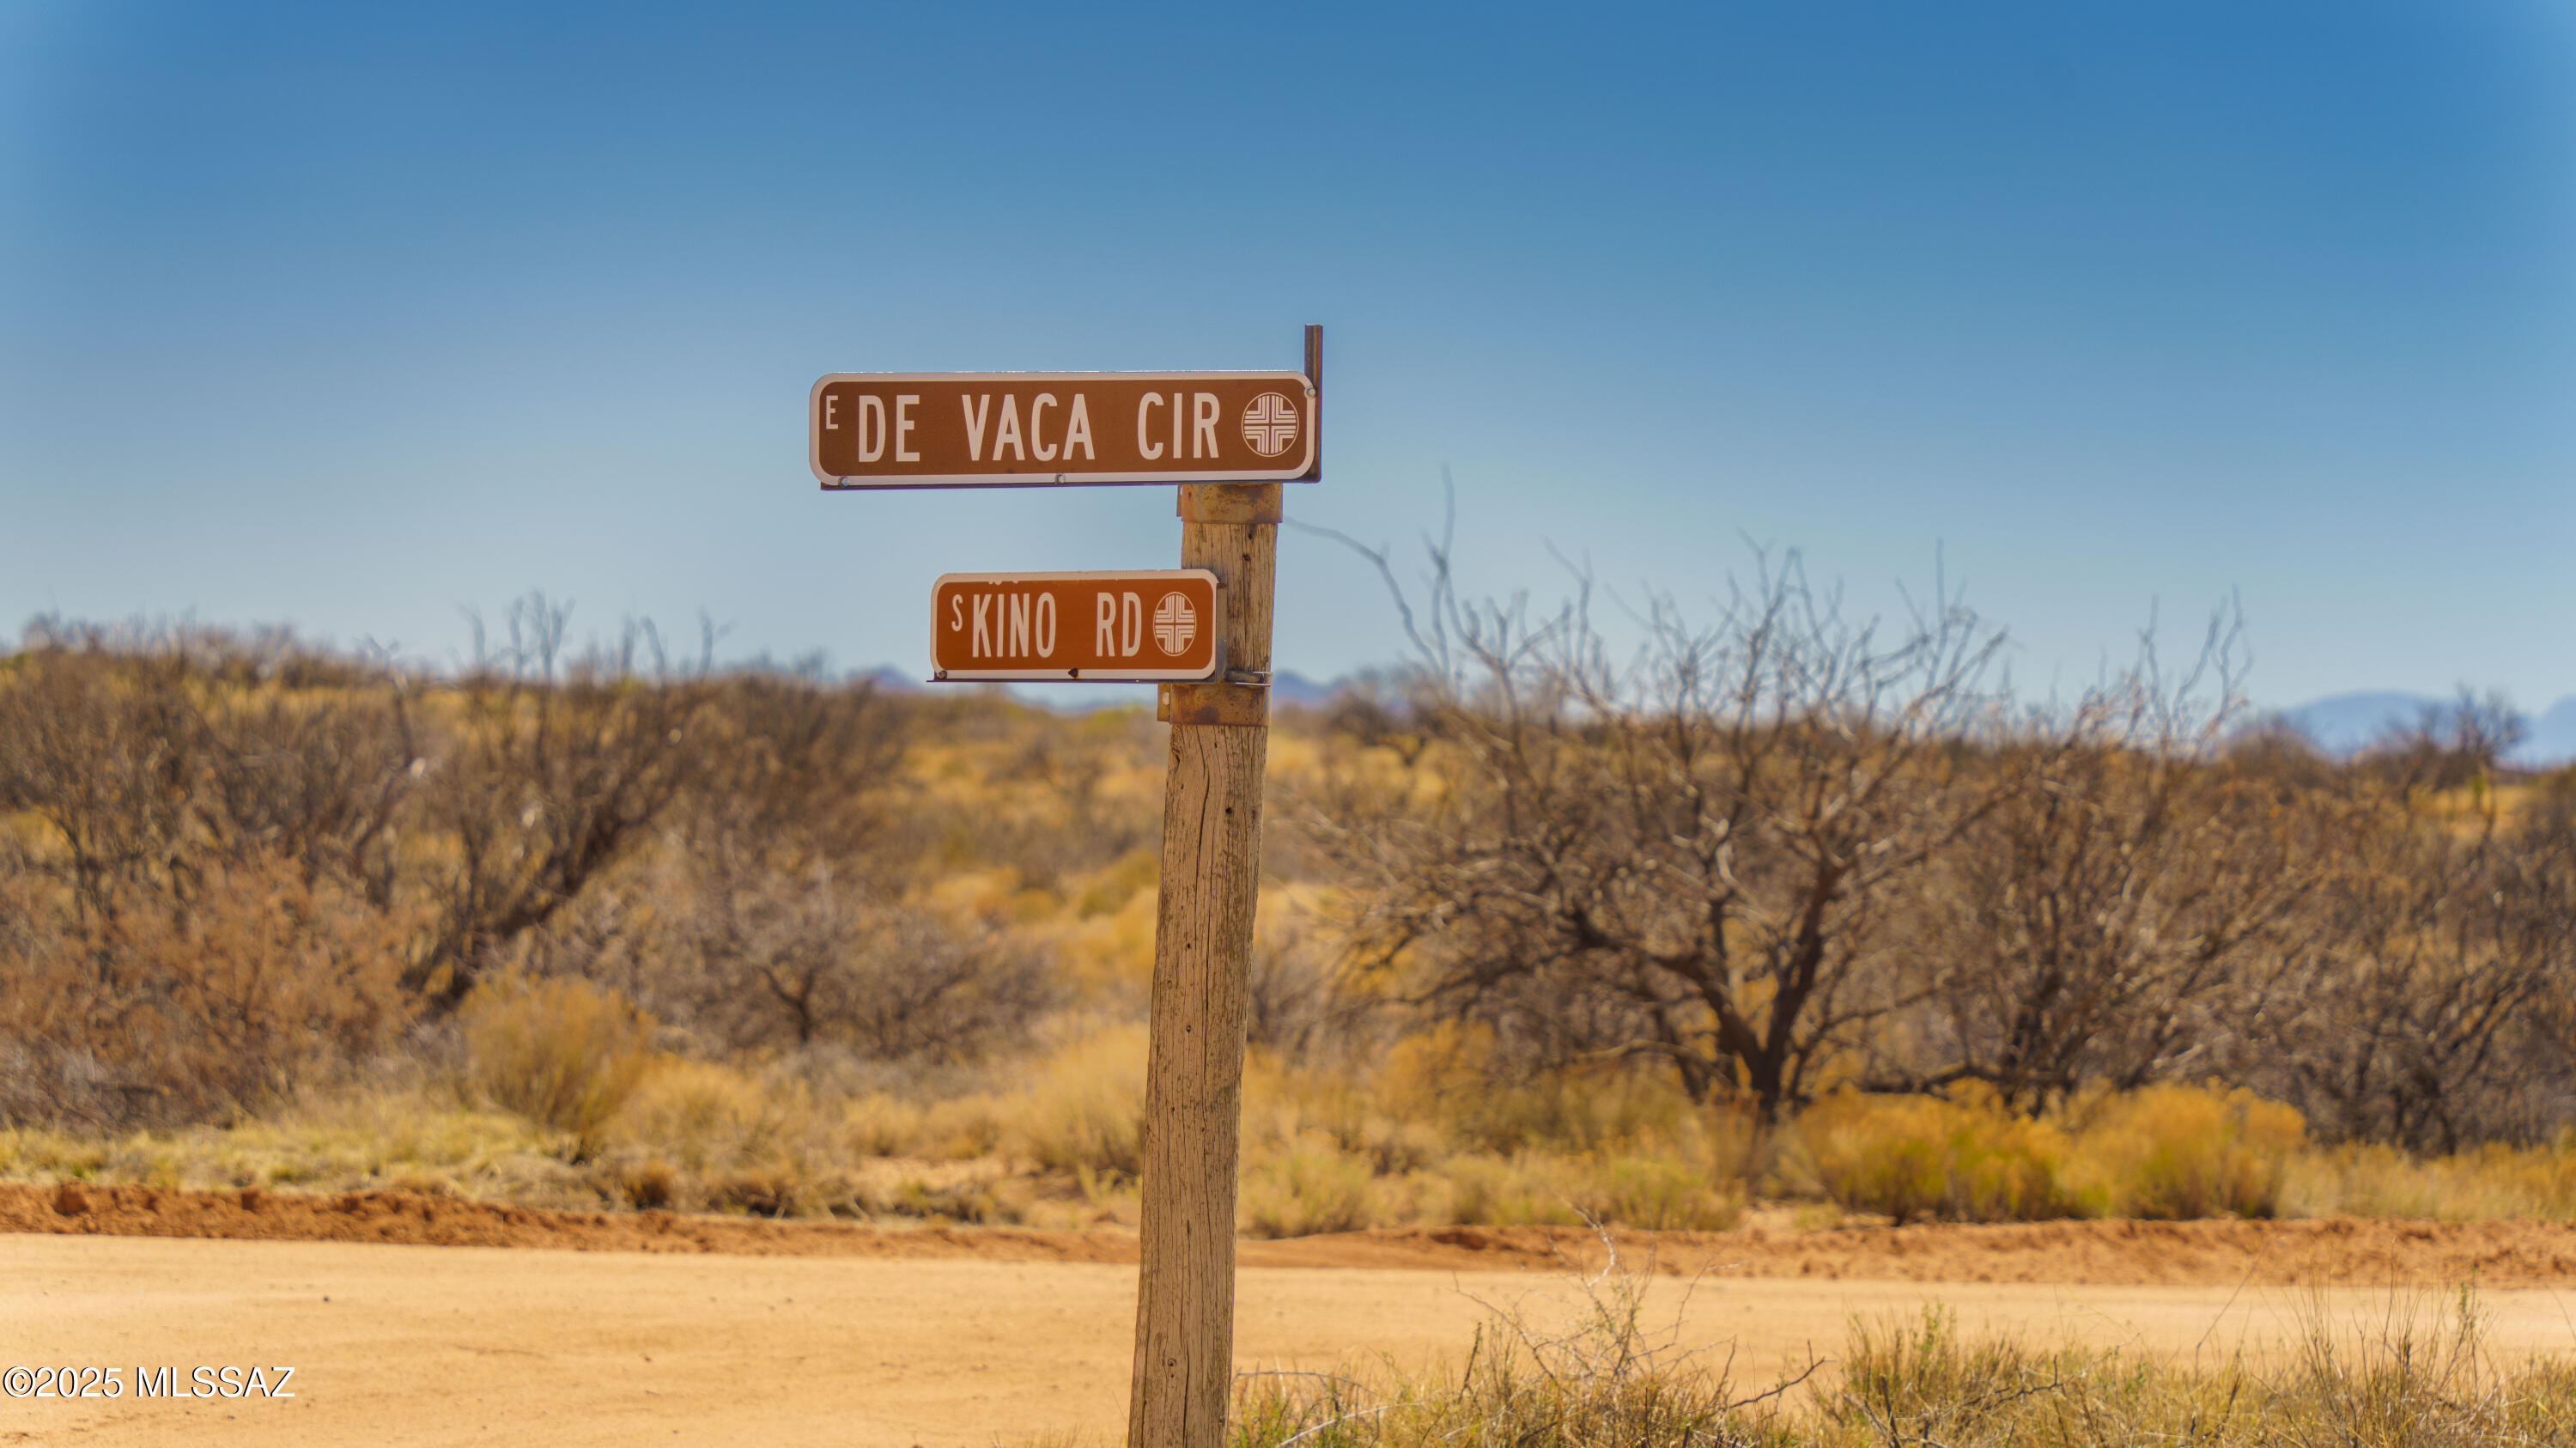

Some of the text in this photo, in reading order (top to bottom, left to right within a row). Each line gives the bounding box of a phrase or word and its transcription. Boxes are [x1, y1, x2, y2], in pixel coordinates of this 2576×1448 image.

[826, 392, 1220, 462] E DE VACA CIR
[951, 592, 1142, 658] S KINO RD
